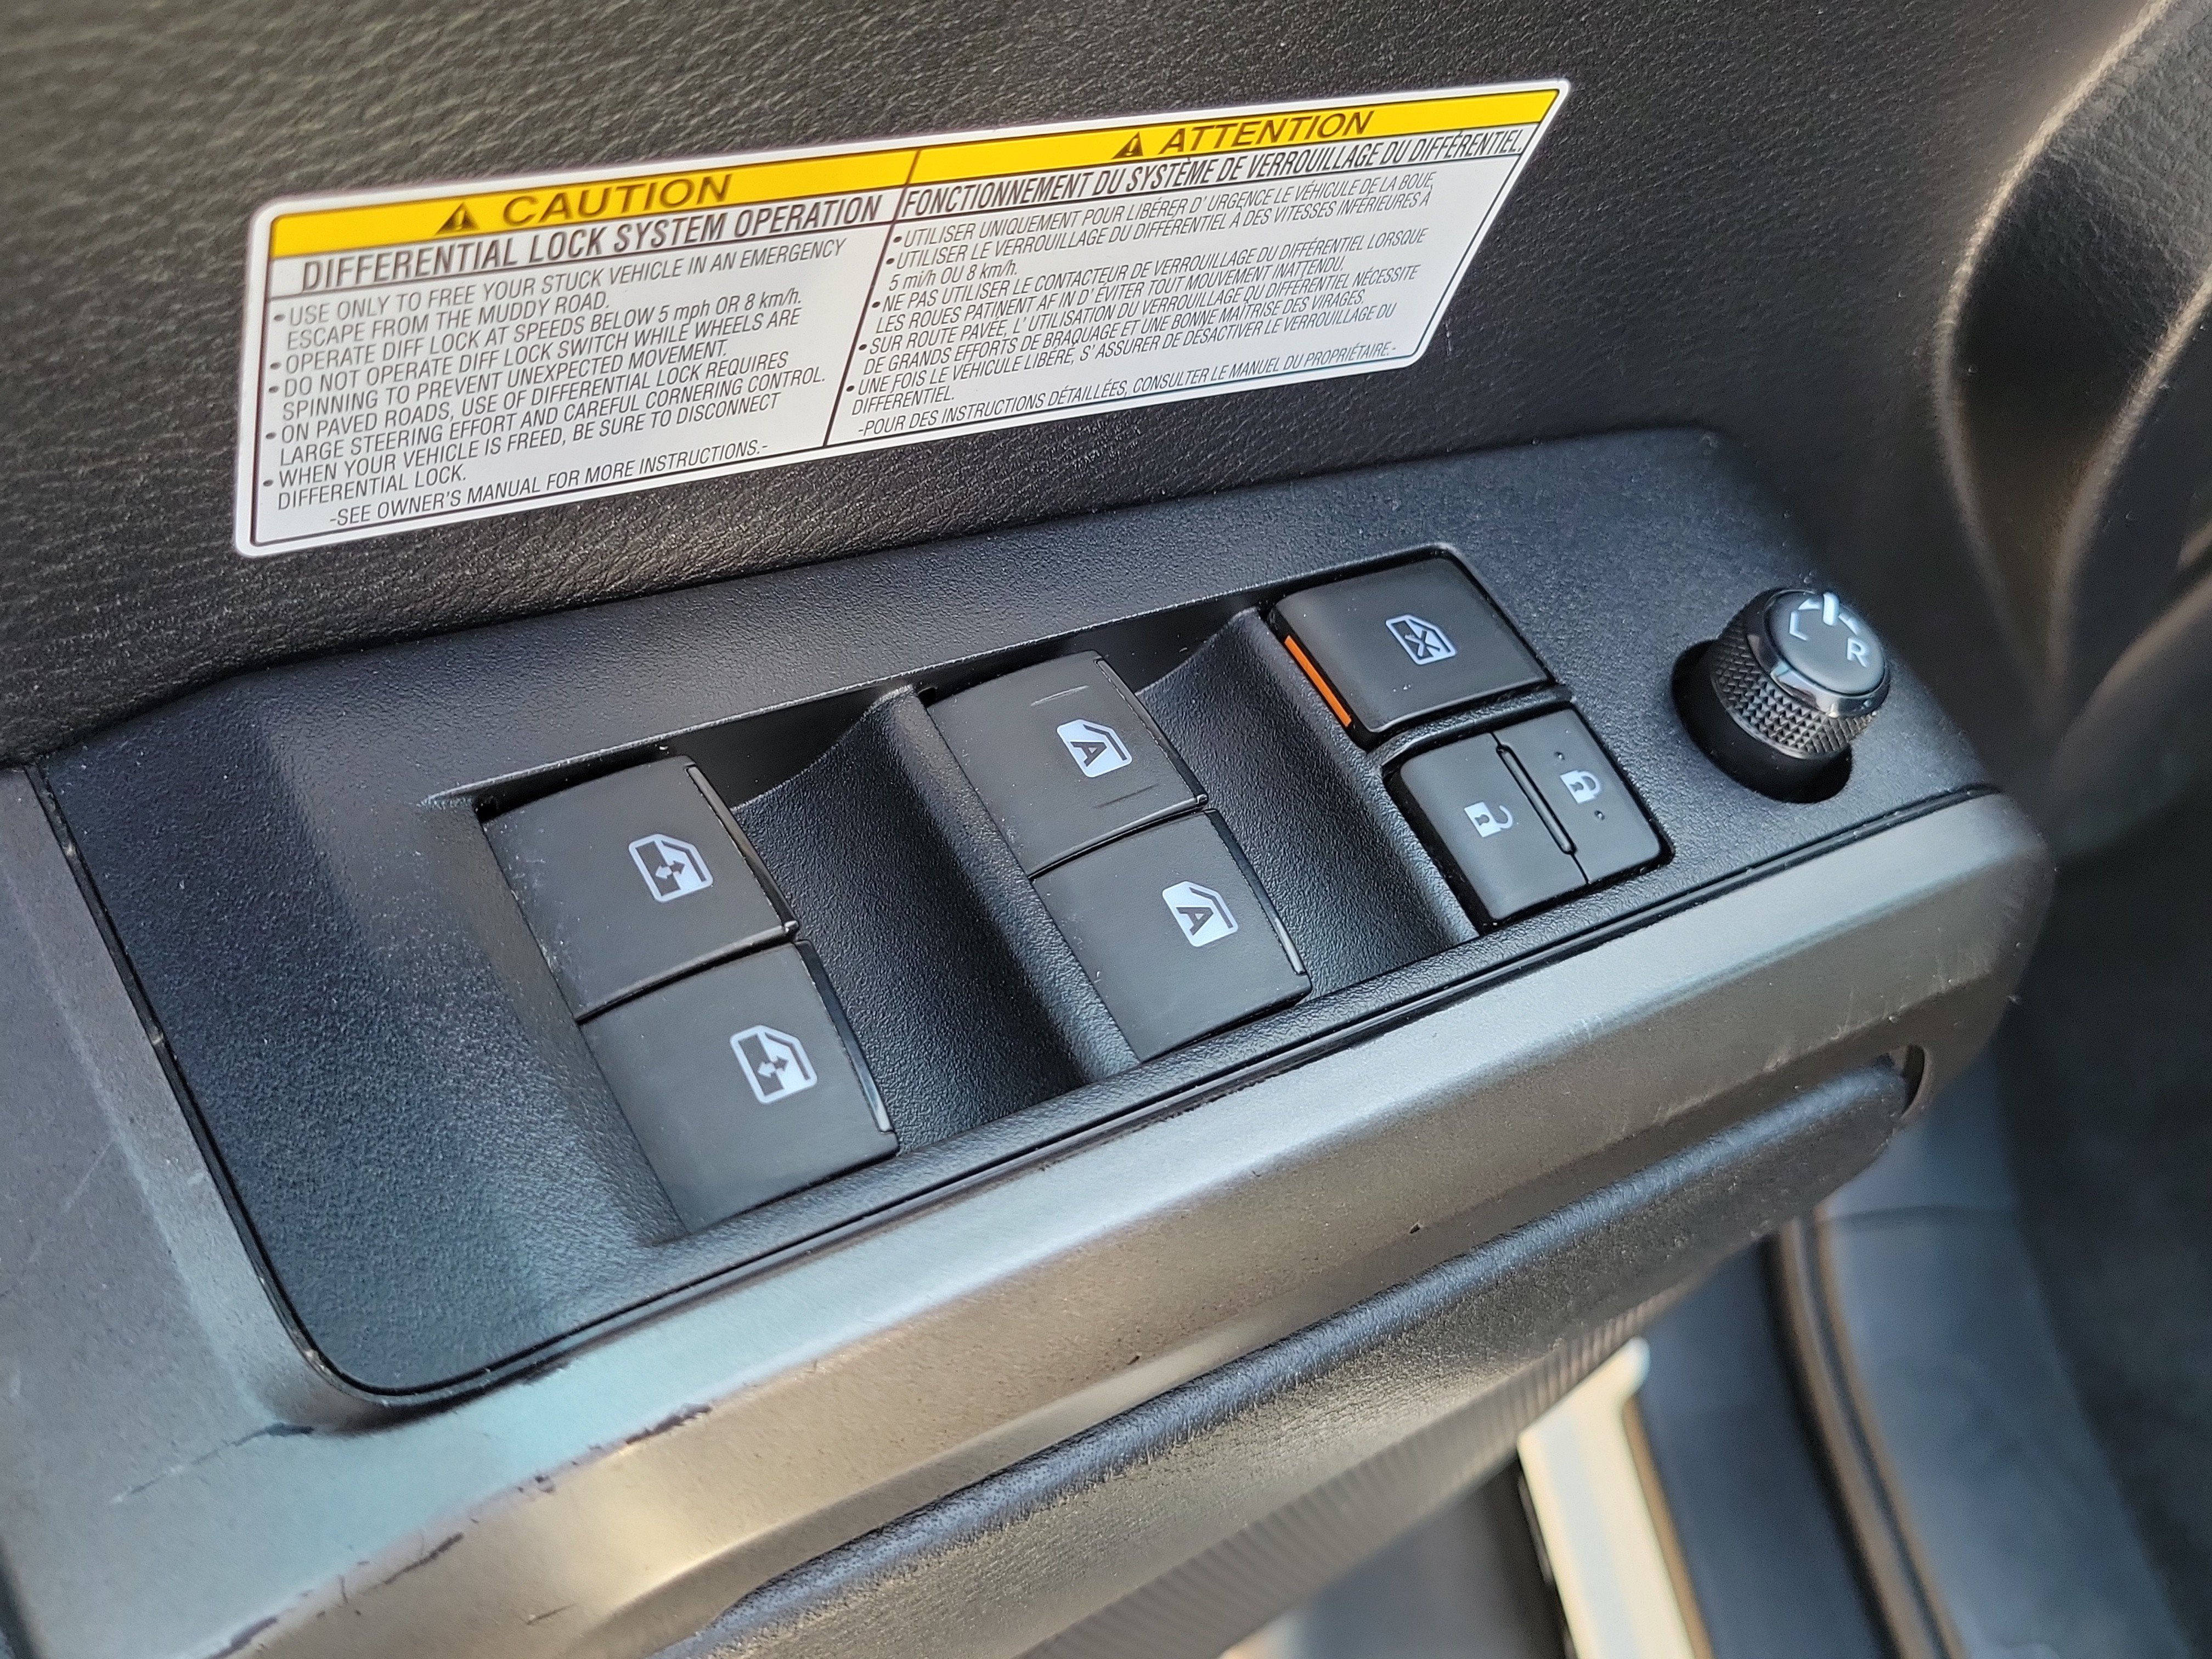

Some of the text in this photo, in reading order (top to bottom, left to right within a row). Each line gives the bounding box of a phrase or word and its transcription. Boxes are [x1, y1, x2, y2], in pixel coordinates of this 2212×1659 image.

[1159, 110, 1373, 154] ATTENTION
[503, 174, 731, 226] CAUTION
[902, 172, 1093, 217] FONCTIONNEMENT
[1091, 167, 1126, 196] DU
[1125, 155, 1218, 192] SYSTÈME
[1215, 155, 1248, 182] DE
[1246, 142, 1383, 178] VERROUILLAGE
[1379, 139, 1412, 165] DU
[903, 222, 976, 247] UTILISER
[979, 210, 1080, 239] UNIQUEMENT
[1081, 205, 1125, 226] POUR
[1273, 185, 1295, 204] LE
[302, 195, 882, 291] DIFFERENTIAL LOCK SYSTEM OPERATION
[882, 292, 906, 313] NE
[906, 288, 939, 309] PAS
[941, 279, 1011, 304] UTILISER
[1012, 276, 1034, 295] LE
[1034, 264, 1129, 292] CONTACTEUR
[1129, 261, 1153, 279] DE
[1154, 247, 1257, 276] VERROUILLAGE
[1255, 245, 1279, 263] DU
[1367, 227, 1429, 249] LORSQUE
[896, 244, 968, 269] UTILISER
[970, 240, 993, 260] LE
[995, 227, 1109, 256] VERROUILLAGE
[1108, 224, 1133, 243] DU
[1242, 207, 1272, 227] DES
[1273, 200, 1337, 223] VITESSES
[289, 238, 846, 326] USE ONLY TO FREE YOUR STUCK VEHICLE IN AN EMERGENCY
[875, 264, 1273, 334] LES ROUES PATINENT TOUT MOUVEMENT
[888, 273, 901, 291] 5
[901, 269, 936, 290] mi/h
[940, 264, 964, 285] OU
[966, 263, 978, 281] 8
[284, 307, 802, 398] DO NOT OPERATE DIFF LOCK SWITCH WHILE WHEELS ARE
[285, 287, 801, 374] OPERATE DIFF LOCK AT SPEEDS BELOW 5 mph OR 8 km/h.
[287, 290, 609, 351] ESCAPE FROM THE MUDDY ROAD.
[857, 374, 891, 396] UNE
[929, 365, 950, 385] LE
[1161, 331, 1183, 349] DE
[1263, 317, 1283, 335] LE
[1283, 305, 1377, 331] VERROUILLAGE
[1375, 302, 1397, 319] DU
[862, 356, 886, 375] DE
[888, 346, 952, 371] GRANDS
[1019, 332, 1042, 352] DE
[1140, 314, 1171, 334] UNE
[1281, 295, 1310, 314] DES
[869, 334, 903, 354] SUR
[905, 325, 959, 349] ROUTE
[1116, 300, 1140, 319] DU
[1142, 286, 1244, 315] VERROUILLAGE
[280, 366, 825, 466] LARGE STEERING EFFORT AND CAREFUL CORNERING CONTROL.
[281, 351, 788, 443] ON PAVED ROADS, USE OF DIFFERENTIAL LOCK REQUIRES
[283, 338, 727, 421] SPINNING TO PREVENT UNEXPECTED MOVEMENT.
[908, 409, 939, 428] DES
[941, 392, 1046, 424] INSTRUCTIONS
[1132, 367, 1210, 393] CONSULTER
[1210, 364, 1229, 381] LE
[1228, 357, 1280, 379] MANUEL
[1282, 353, 1304, 371] DU
[279, 392, 778, 488] WHEN YOUR VEHICLE IS FREED, BE SURE TO DISCONNECT
[278, 463, 466, 510] DIFFERENTIAL LOCK.
[329, 439, 767, 526] -SEE OWNER'S MANUAL FOR MORE INSTRUCTIONS.-
[1847, 637, 1870, 667] R
[1069, 741, 1107, 767] A
[1176, 906, 1214, 935] A
